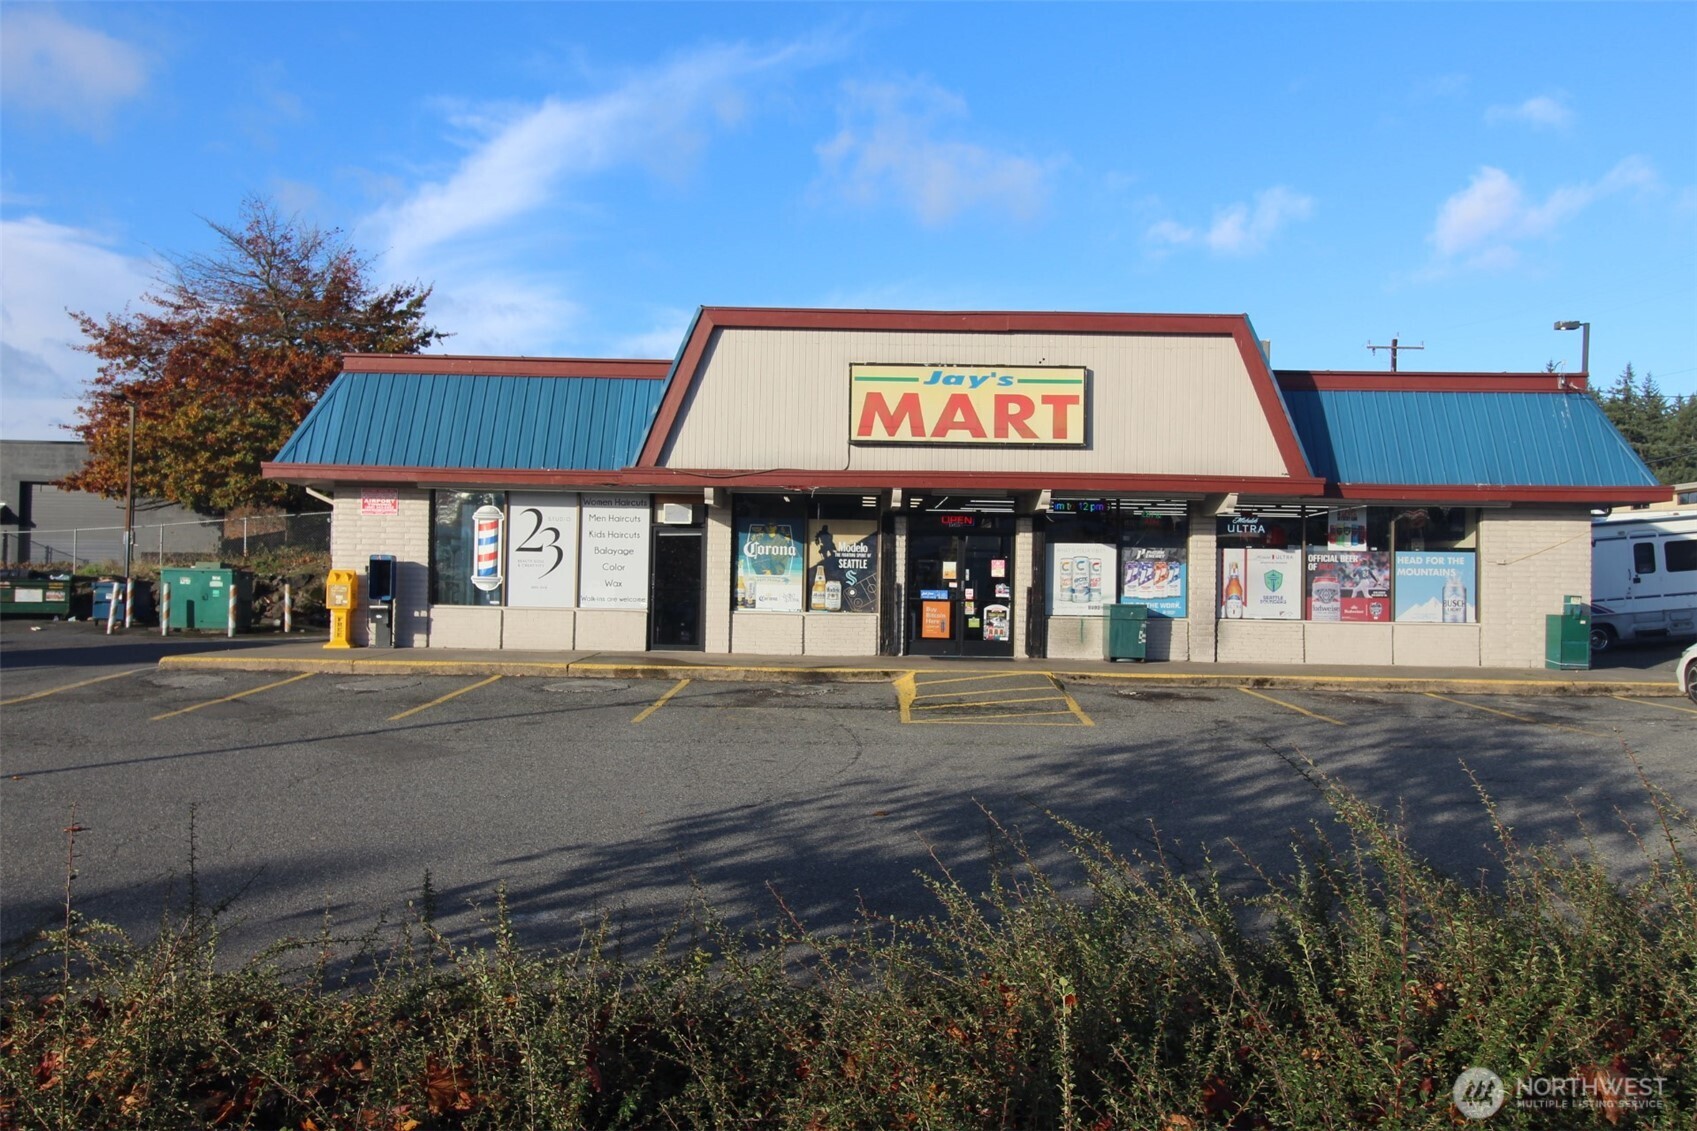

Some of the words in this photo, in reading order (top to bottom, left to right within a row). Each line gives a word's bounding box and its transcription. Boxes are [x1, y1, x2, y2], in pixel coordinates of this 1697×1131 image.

[923, 370, 1014, 389] Jay's
[856, 392, 1080, 440] MART
[583, 498, 612, 506] Women
[614, 498, 648, 507] Haircuts
[588, 514, 606, 522] Men
[608, 514, 641, 522] Haircuts
[941, 516, 972, 524] OPEN
[1227, 524, 1266, 533] ULTRA
[515, 508, 564, 580] 23
[838, 542, 868, 552] Modelo
[594, 546, 634, 556] Balayage
[743, 541, 796, 559] Corona
[1308, 554, 1338, 562] OFFICIAL
[602, 562, 625, 571] Color
[838, 559, 868, 569] SEATTLE
[1397, 568, 1456, 576] MOUNTAINS
